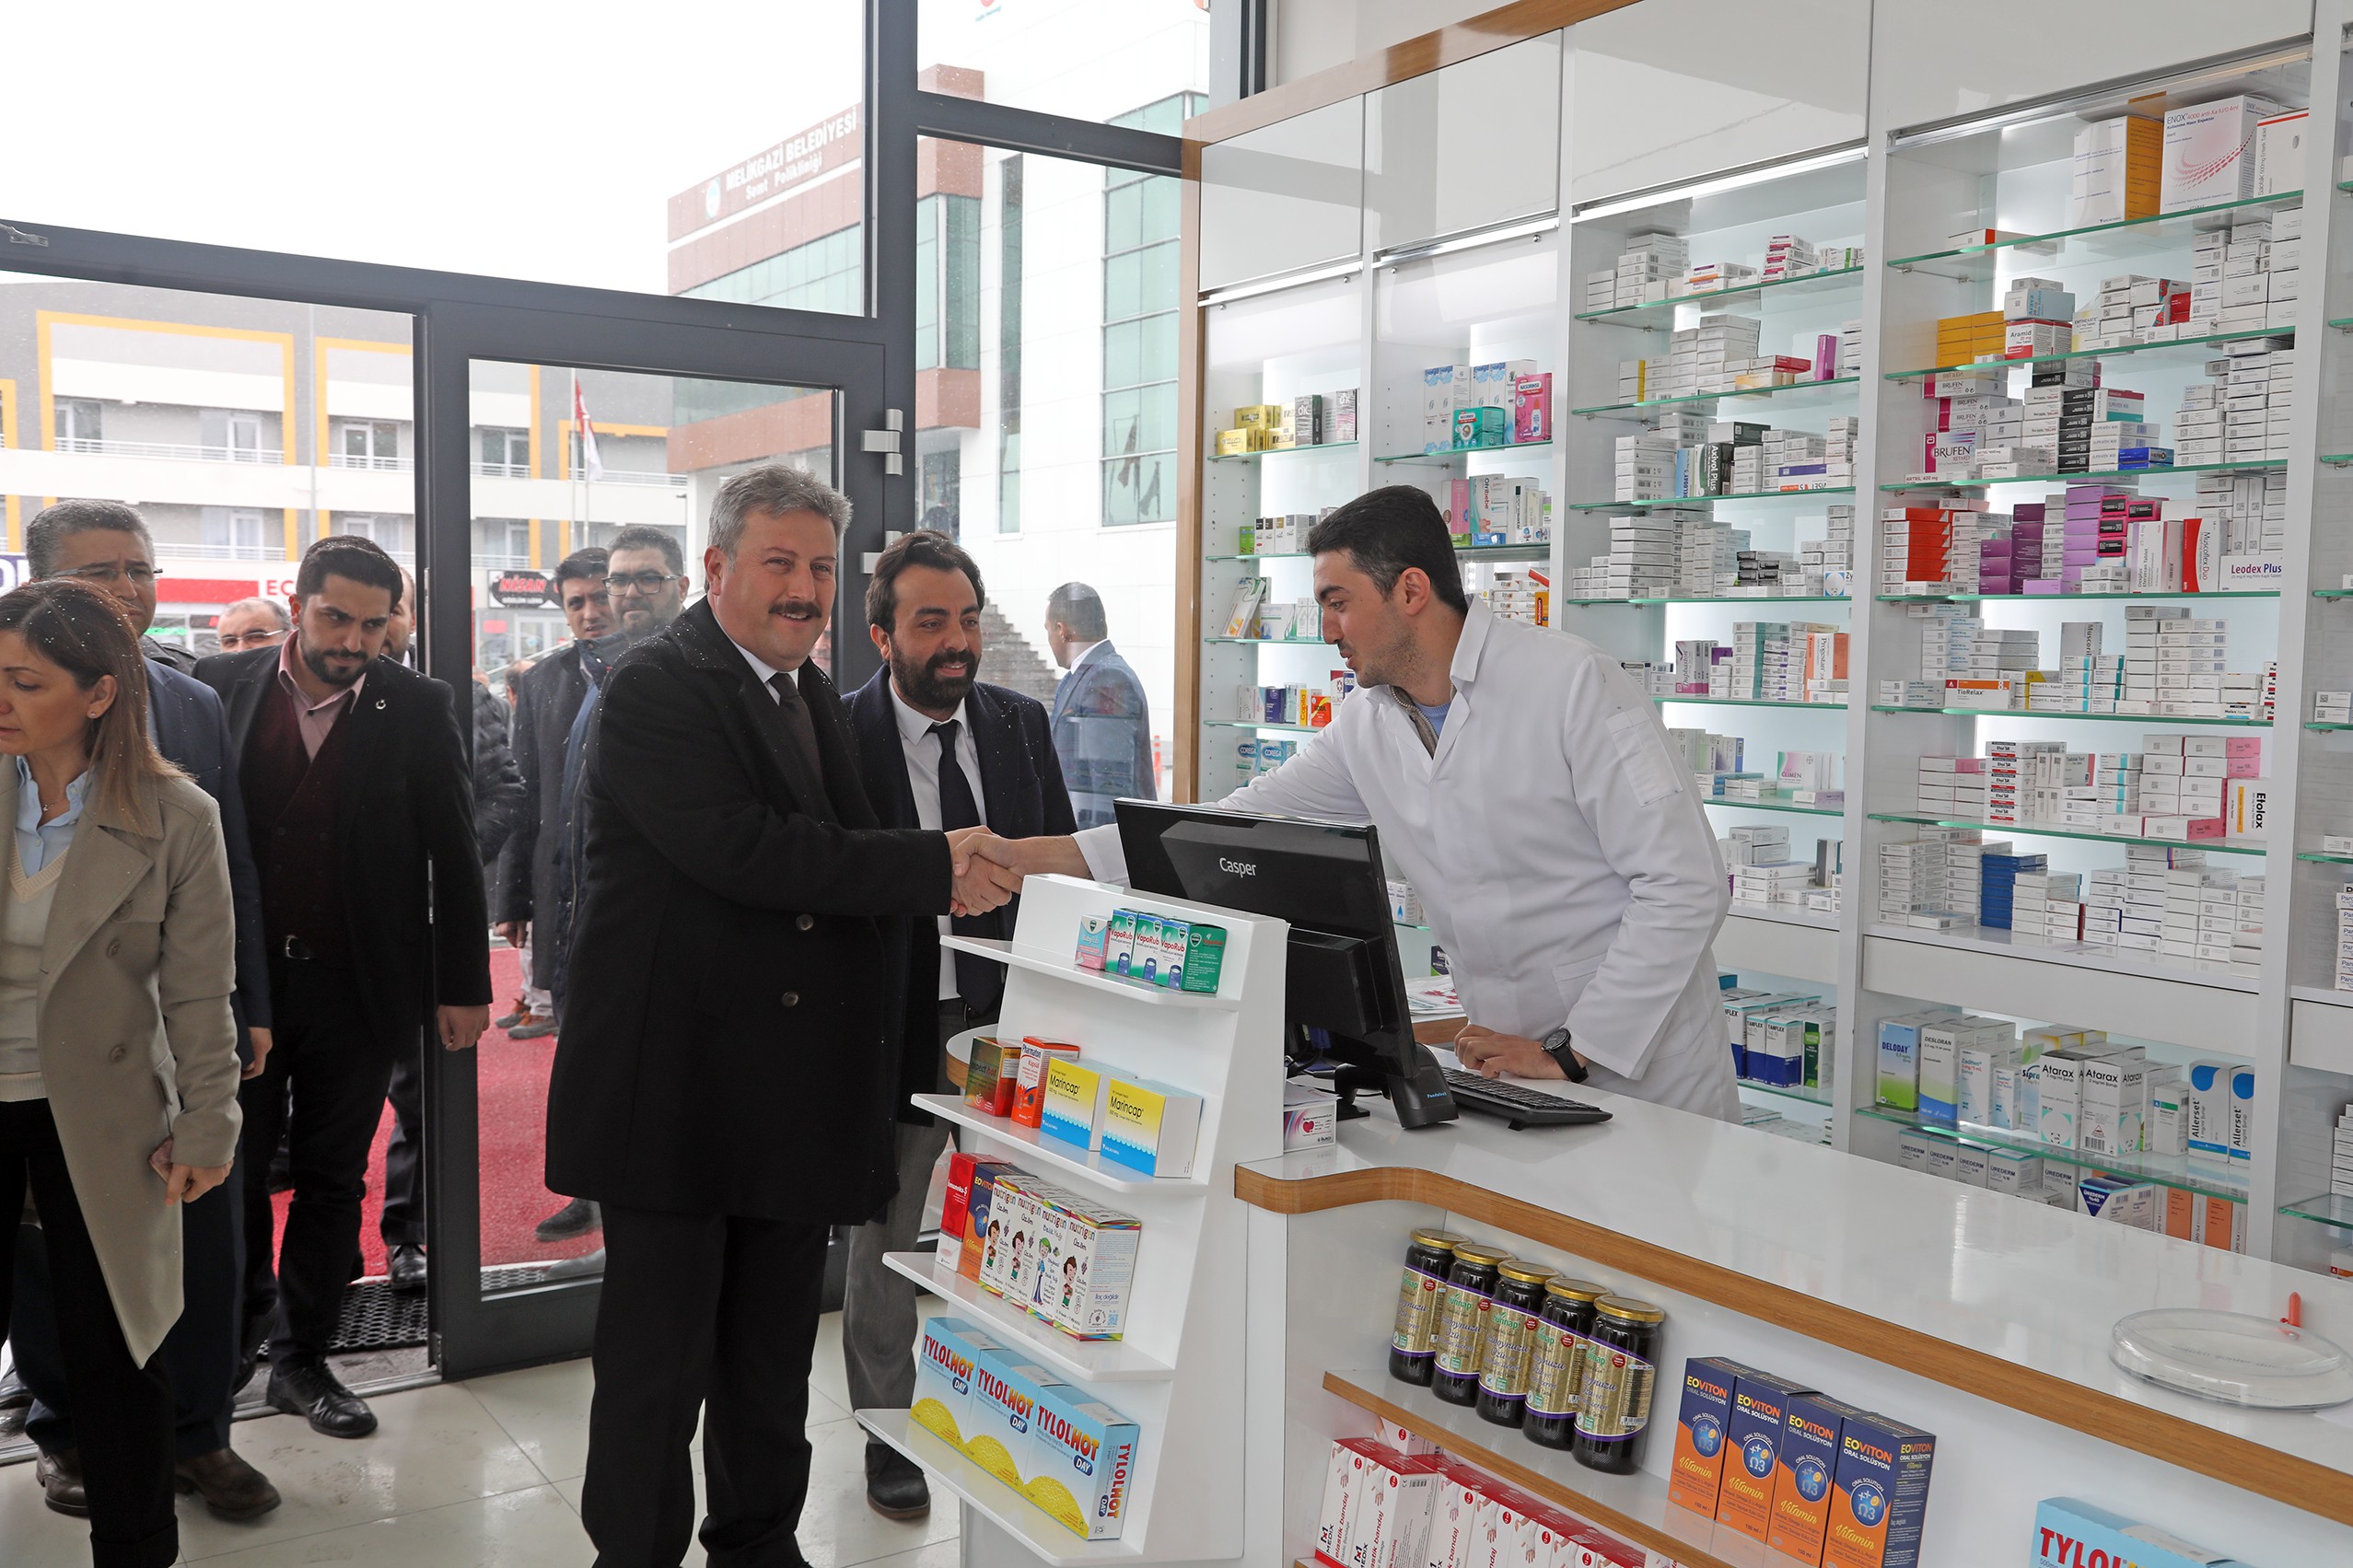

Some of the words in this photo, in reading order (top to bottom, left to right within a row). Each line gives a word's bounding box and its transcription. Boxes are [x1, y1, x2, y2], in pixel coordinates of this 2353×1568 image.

[786, 106, 857, 164] BELEDİYESİ
[1957, 398, 1978, 406] BRUFEN
[1711, 445, 1719, 472] Axivol
[1934, 446, 1971, 458] BRUFEN
[2231, 563, 2262, 574] Leodex
[2264, 563, 2282, 574] Plus
[2256, 792, 2266, 829] Etolax
[1219, 857, 1256, 877] Casper
[1111, 928, 1133, 940] VapoRub
[1136, 933, 1159, 945] VapoRub
[1161, 939, 1185, 952] VapoRub
[1881, 1041, 1908, 1053] DELODAY
[1925, 1037, 1951, 1046] DESLORAN
[2042, 1064, 2074, 1078] Atarax
[2086, 1069, 2117, 1083] Atarax
[1050, 1074, 1080, 1096] Marincap
[1110, 1096, 1144, 1120] Marincap
[2192, 1100, 2200, 1138] Allerset
[2233, 1109, 2242, 1147] Allerset
[994, 1187, 1016, 1205] nutrigen
[1018, 1197, 1042, 1215] nutrigen
[1042, 1210, 1067, 1229] nutrigen
[1069, 1221, 1096, 1241] nutrigen
[953, 1379, 967, 1394] DAY
[1686, 1386, 1700, 1398] ORAL
[1701, 1391, 1726, 1406] SOLÜSYON
[1012, 1417, 1027, 1432] DAY
[1703, 1412, 1720, 1425] SOLUTION
[1736, 1405, 1750, 1415] ORAL
[1751, 1410, 1779, 1425] SOLÜSYON
[1753, 1432, 1774, 1446] SOLUTION
[1788, 1426, 1802, 1437] ORAL
[1803, 1432, 1833, 1448] SOLÜSYON
[1075, 1457, 1091, 1473] DAY
[1679, 1456, 1713, 1480] Vitamin
[1806, 1454, 1826, 1469] SOLUTION
[1843, 1447, 1858, 1459] ORAL
[1859, 1455, 1890, 1471] SOLÜSYON
[1729, 1476, 1765, 1501] Vitamin
[1863, 1477, 1884, 1493] SOLUTION
[1100, 1497, 1108, 1516] DAY
[1340, 1492, 1349, 1526] bandaj
[1780, 1500, 1817, 1525] Vitamin
[1374, 1510, 1384, 1544] bandaj
[1335, 1525, 1344, 1558] elastik
[1450, 1527, 1460, 1562] bandaj
[1835, 1524, 1875, 1550] Vitamin
